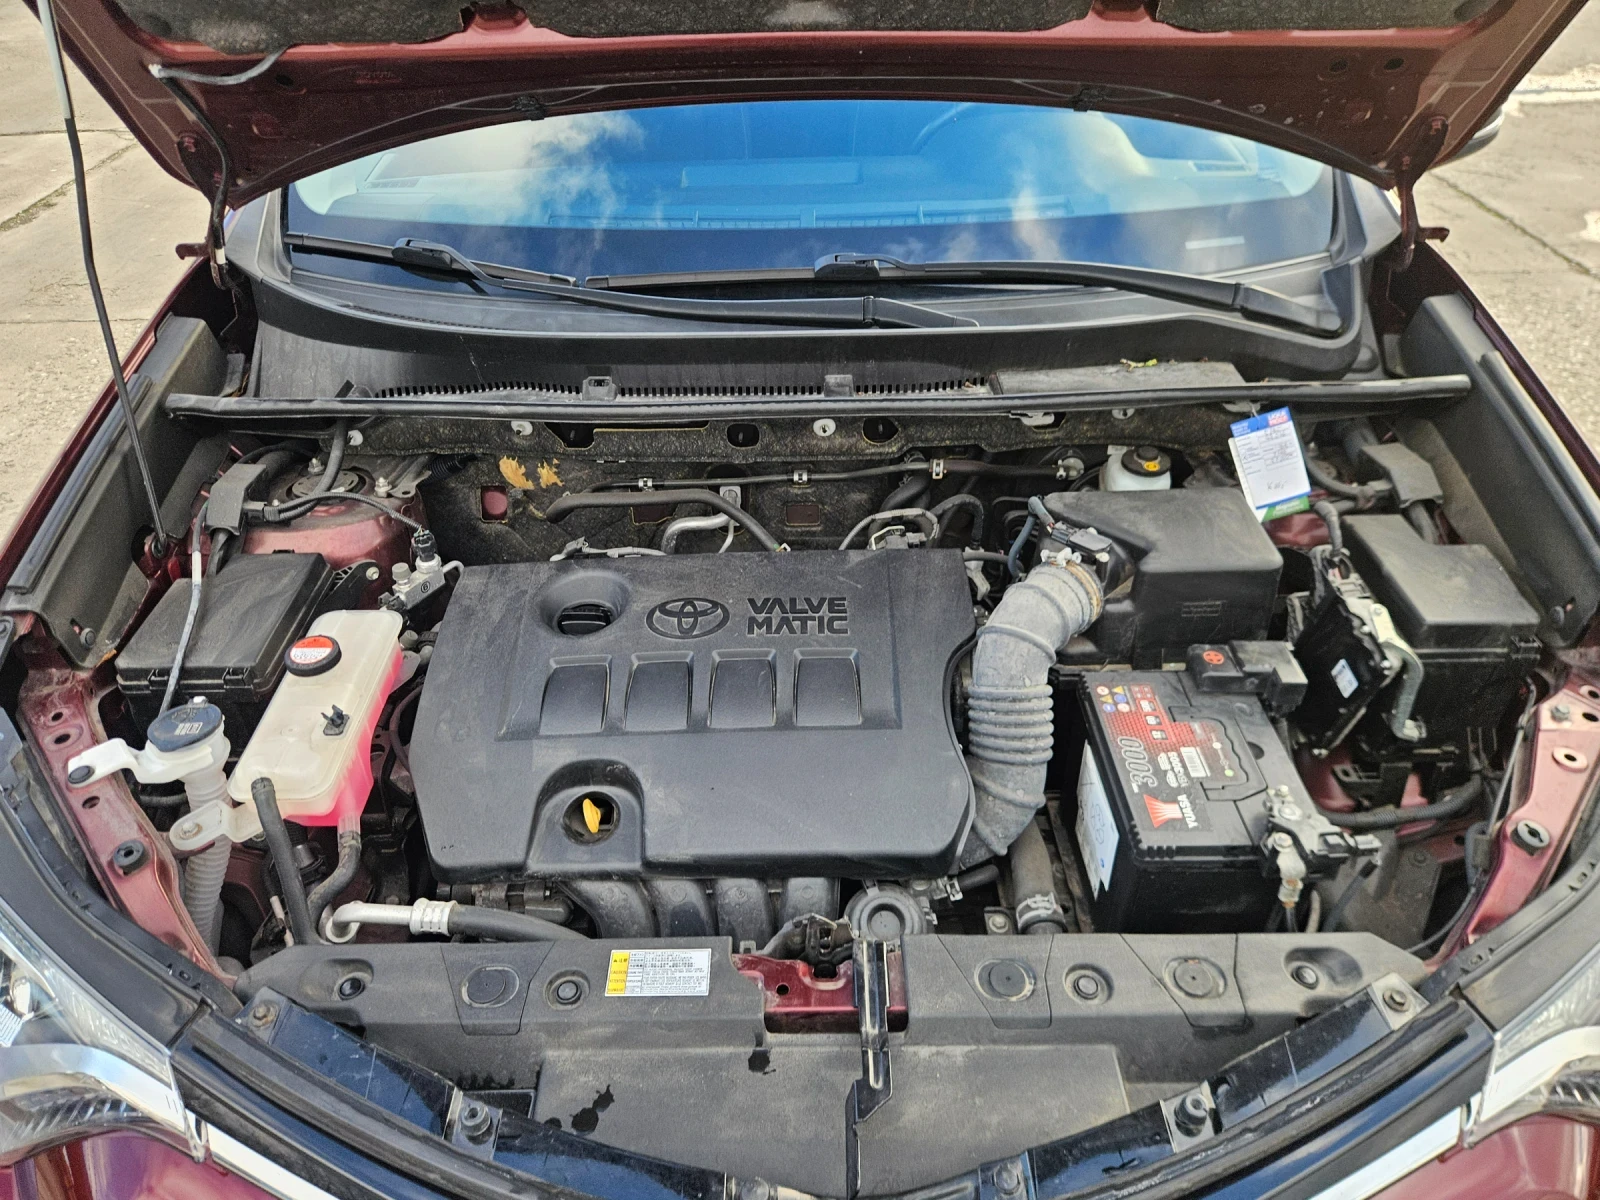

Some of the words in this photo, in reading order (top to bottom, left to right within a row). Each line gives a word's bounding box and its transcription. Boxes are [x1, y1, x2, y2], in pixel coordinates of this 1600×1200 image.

[747, 597, 848, 615] VALVE
[747, 616, 849, 635] MATIC
[1117, 736, 1158, 787] 3000
[1177, 794, 1199, 828] YUASA
